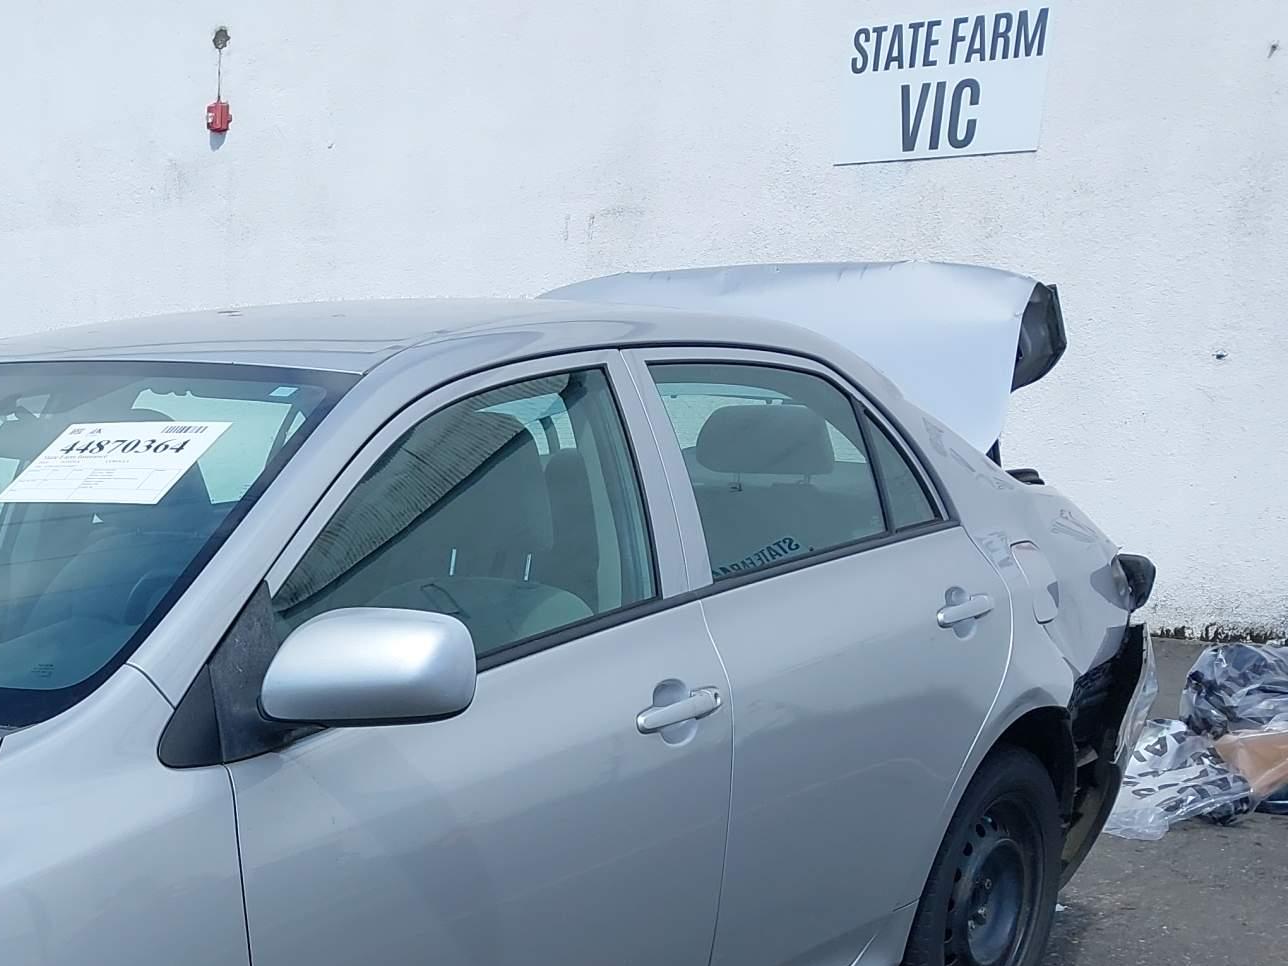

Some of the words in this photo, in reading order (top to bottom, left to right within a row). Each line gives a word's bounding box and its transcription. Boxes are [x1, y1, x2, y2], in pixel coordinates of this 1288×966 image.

[851, 19, 942, 75] STATE
[948, 7, 1050, 65] FARM
[900, 78, 981, 153] VIC
[59, 437, 191, 455] 44870364
